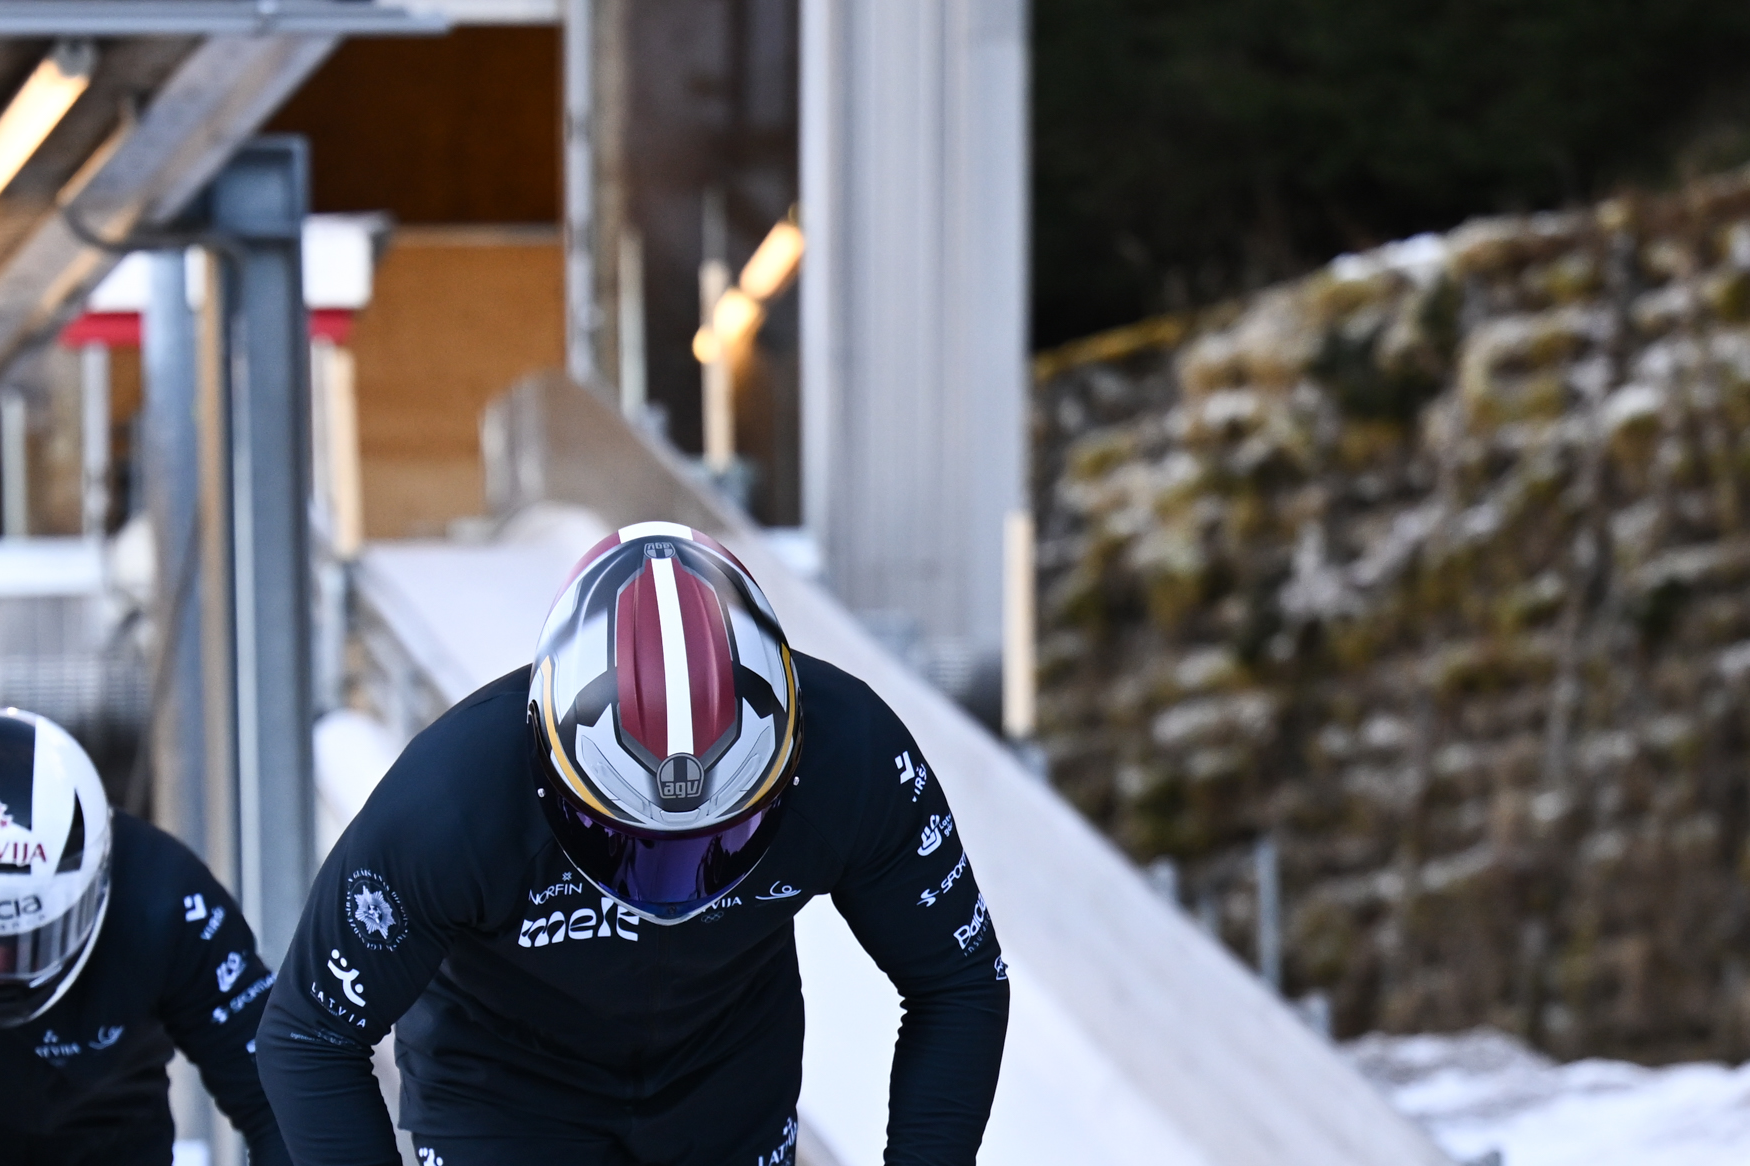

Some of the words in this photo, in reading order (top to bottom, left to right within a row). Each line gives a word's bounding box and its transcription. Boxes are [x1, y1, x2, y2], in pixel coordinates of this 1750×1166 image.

[663, 780, 699, 798] agv
[528, 883, 583, 906] NORFIN
[311, 982, 367, 1028] LATVIA
